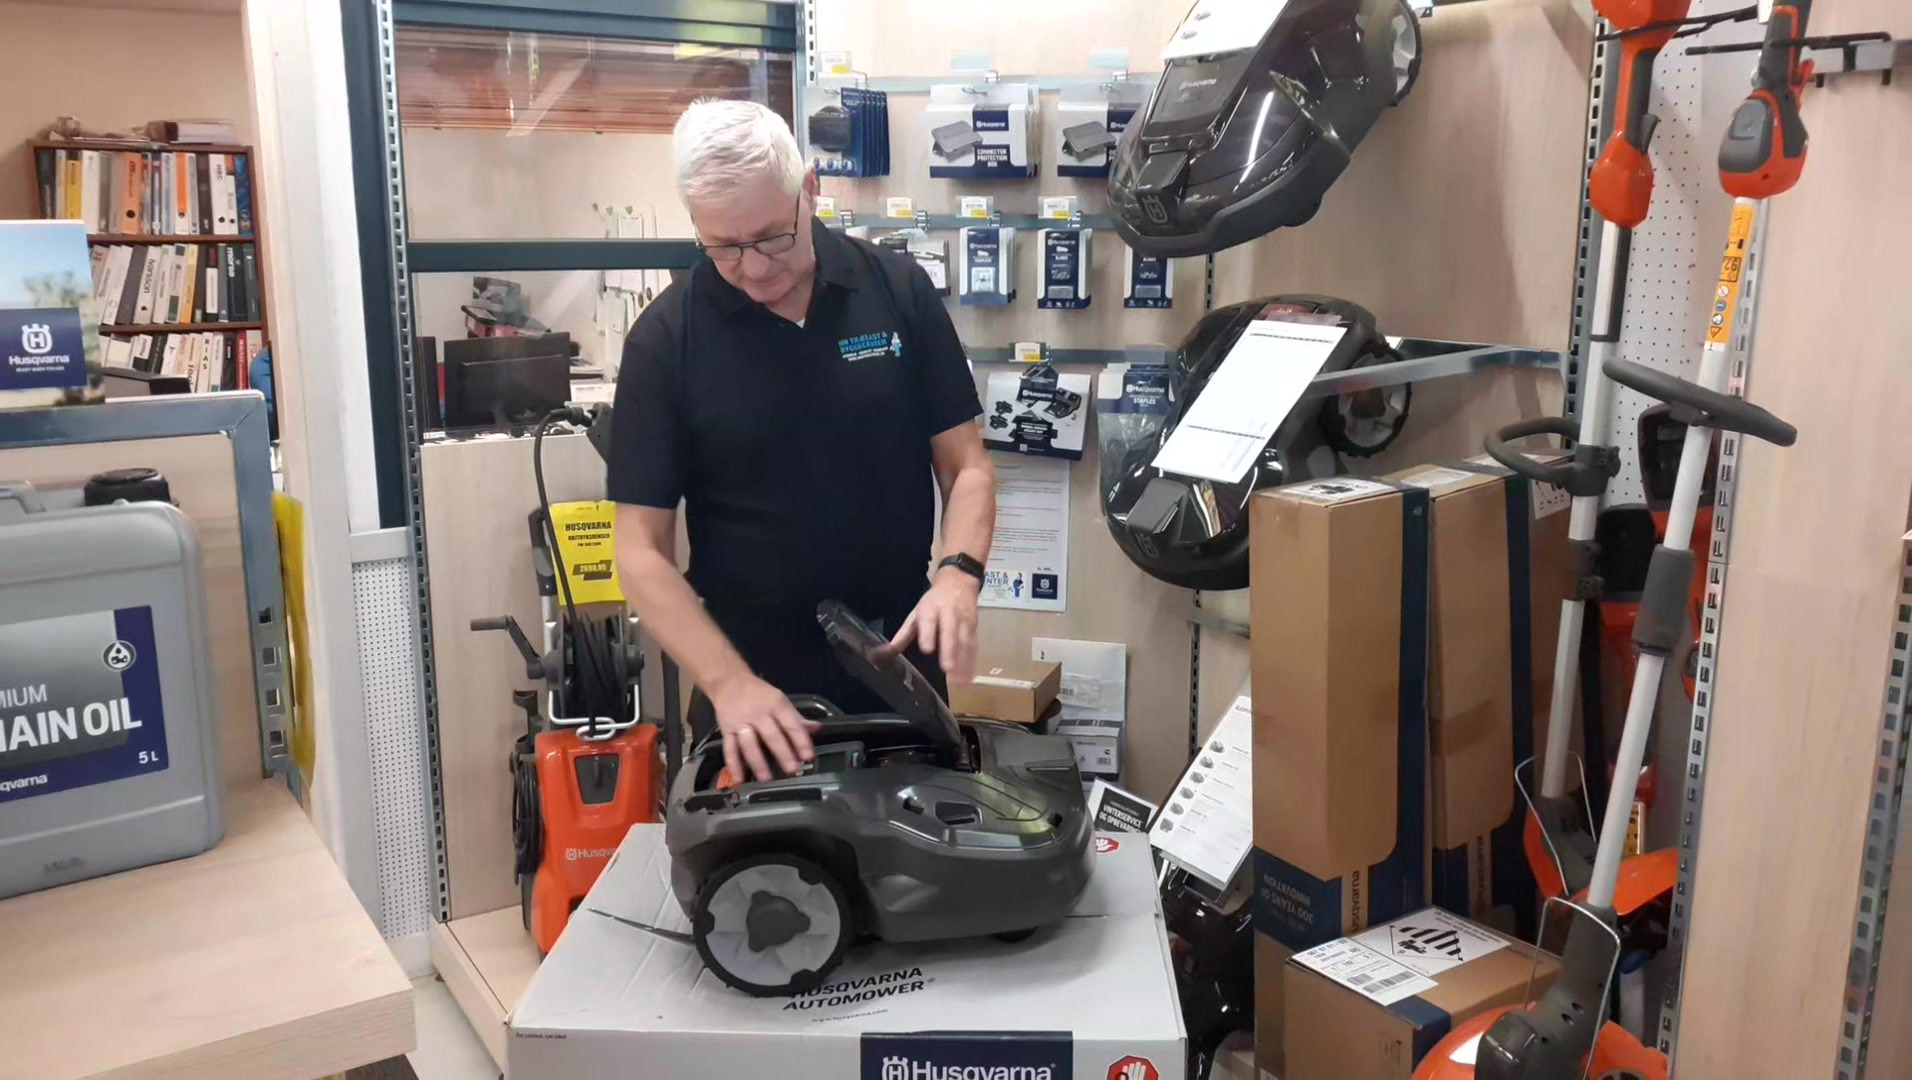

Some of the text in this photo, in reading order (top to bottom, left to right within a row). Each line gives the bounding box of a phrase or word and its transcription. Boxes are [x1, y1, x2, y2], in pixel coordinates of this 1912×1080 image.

[143, 258, 155, 294] Ivarsson
[9, 355, 70, 365] Husqvarna
[1133, 397, 1157, 405] STAPLES
[565, 521, 612, 531] HUSQVARNA
[83, 697, 143, 736] OIL
[139, 751, 159, 764] 5 L
[1103, 804, 1143, 827] VINTERSERVICE
[1263, 873, 1311, 908] INNOVATION
[792, 967, 923, 999] HUSQVARNA
[912, 1061, 1051, 1080] Husqvarna
